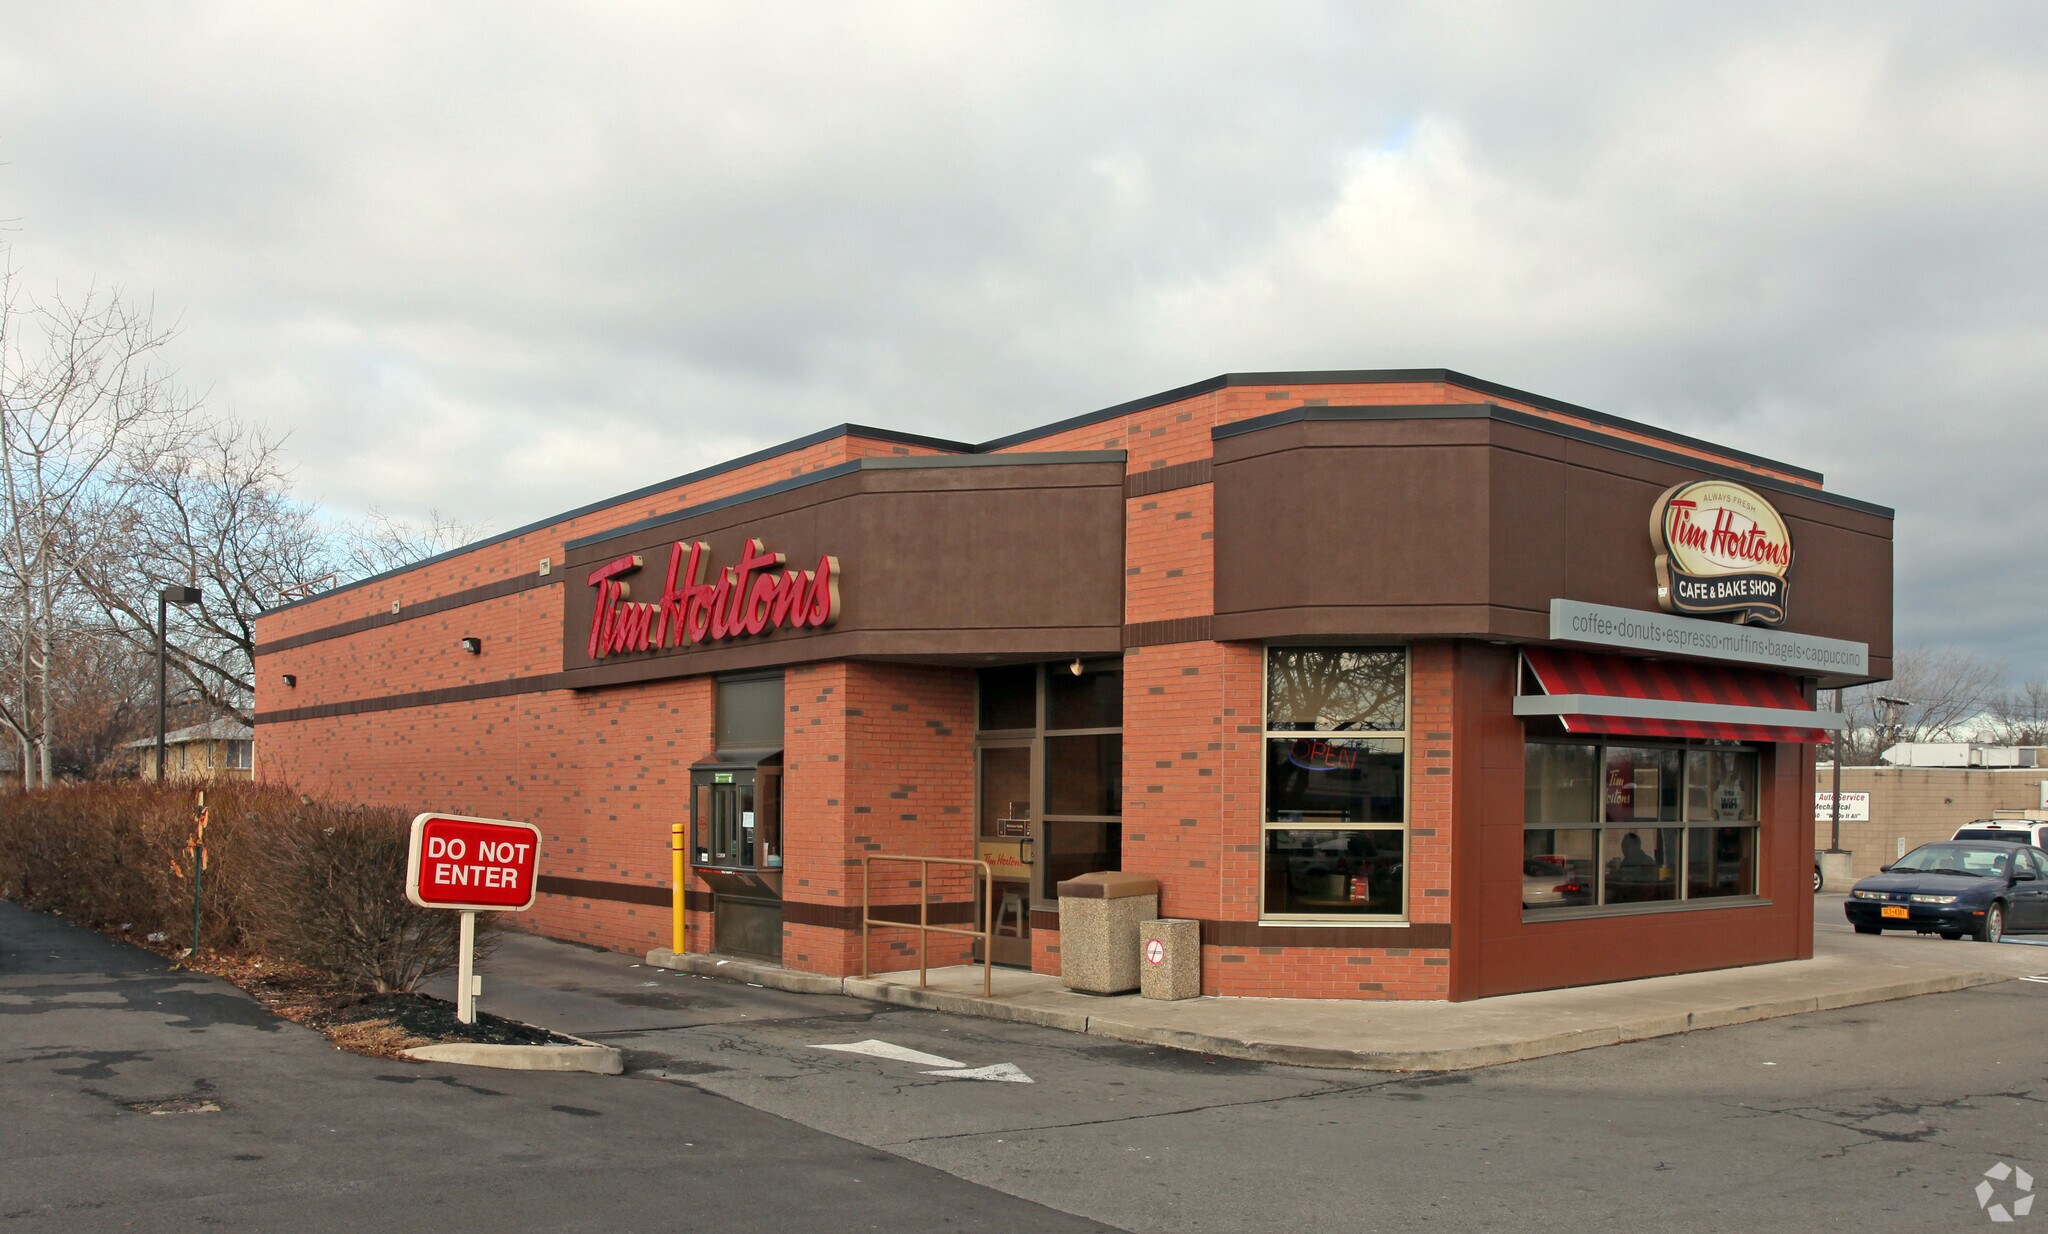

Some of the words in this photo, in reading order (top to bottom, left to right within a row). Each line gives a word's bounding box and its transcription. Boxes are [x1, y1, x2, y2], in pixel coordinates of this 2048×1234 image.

[1703, 494, 1731, 503] ALWAYS
[1733, 497, 1756, 513] FRESH
[1670, 499, 1707, 551] Tim
[1711, 506, 1789, 566] Hortons
[587, 554, 661, 660] Tim
[656, 537, 840, 647] Hortons
[1679, 581, 1708, 599] CAFE
[1709, 586, 1716, 599] &
[1718, 580, 1748, 598] BAKE
[1749, 580, 1776, 597] SHOP
[1290, 739, 1357, 769] OPEN
[1609, 769, 1624, 787] Tim
[1606, 789, 1631, 804] ortons
[428, 837, 466, 860] DO
[478, 841, 530, 864] NOT
[984, 852, 996, 865] Tim
[434, 863, 518, 889] ENTER
